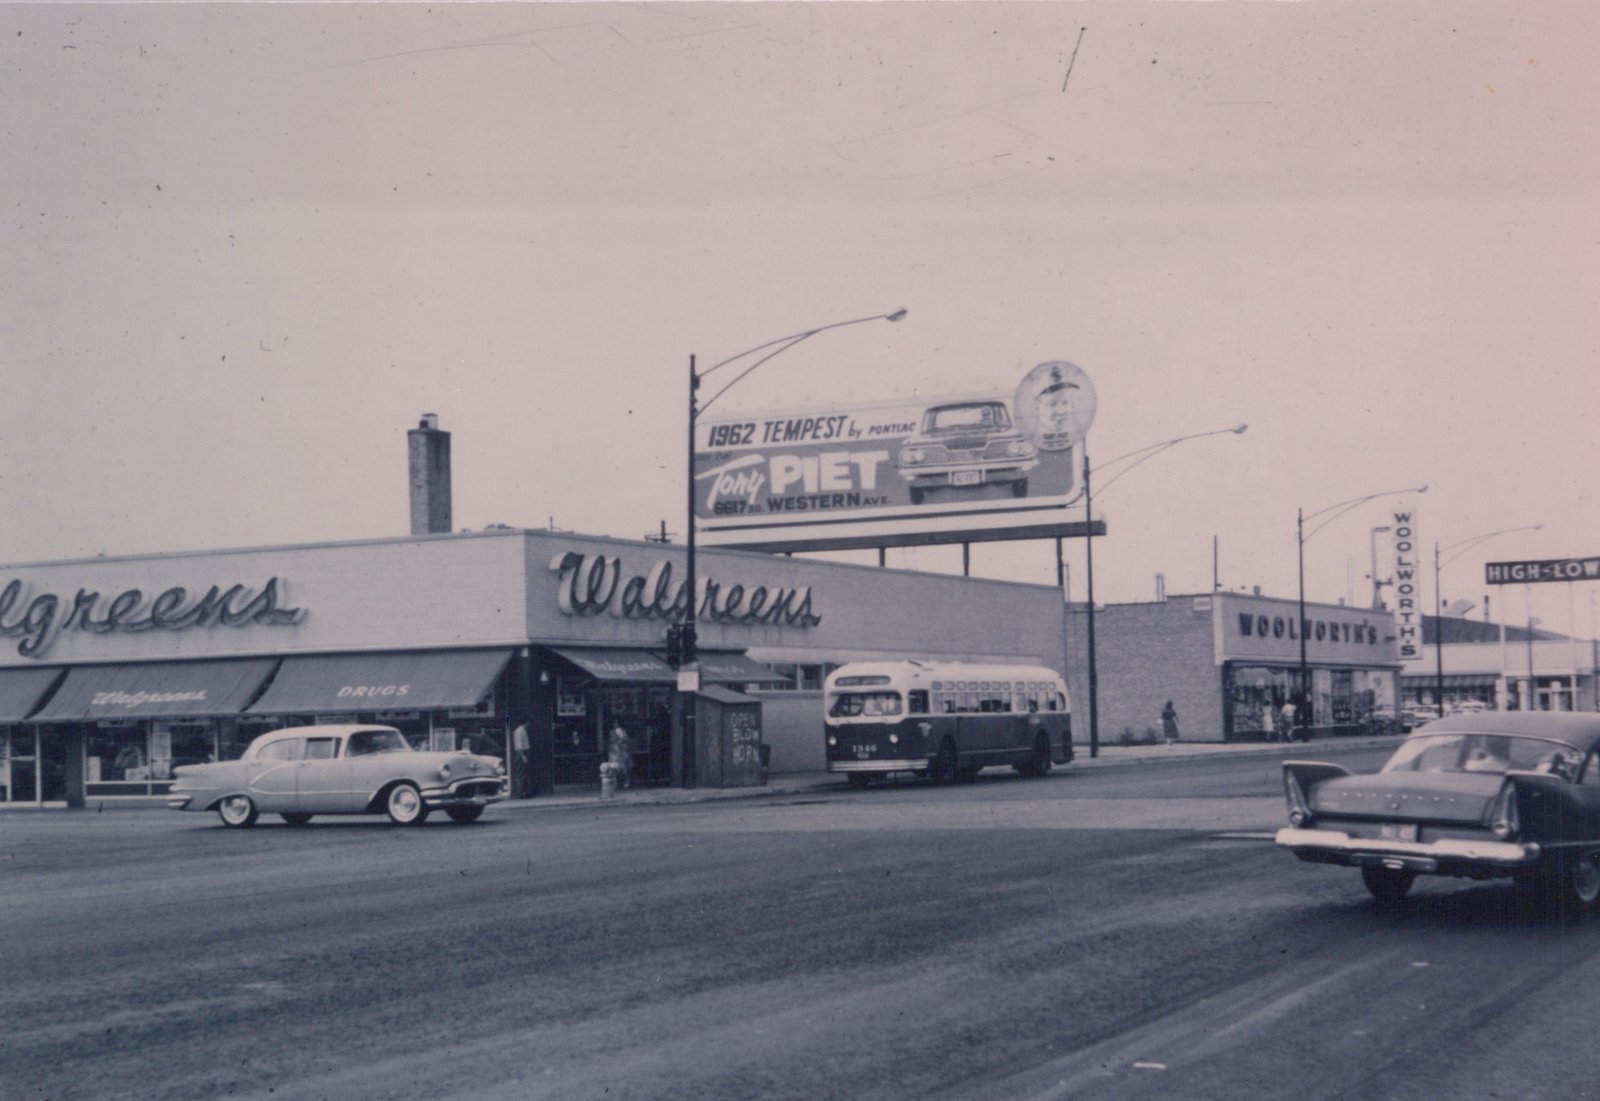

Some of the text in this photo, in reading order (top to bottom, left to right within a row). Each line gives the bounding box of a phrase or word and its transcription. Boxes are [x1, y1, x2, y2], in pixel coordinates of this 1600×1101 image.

[708, 415, 916, 448] 1962 TEMPEST by PONTIAC
[694, 450, 890, 510] Tony PIET
[714, 500, 747, 515] 6617
[766, 493, 860, 512] WESTERN
[1394, 512, 1416, 656] WOOLWORTH'S
[1238, 612, 1377, 645] WOOLWORTH'S
[337, 685, 411, 697] DRUGS
